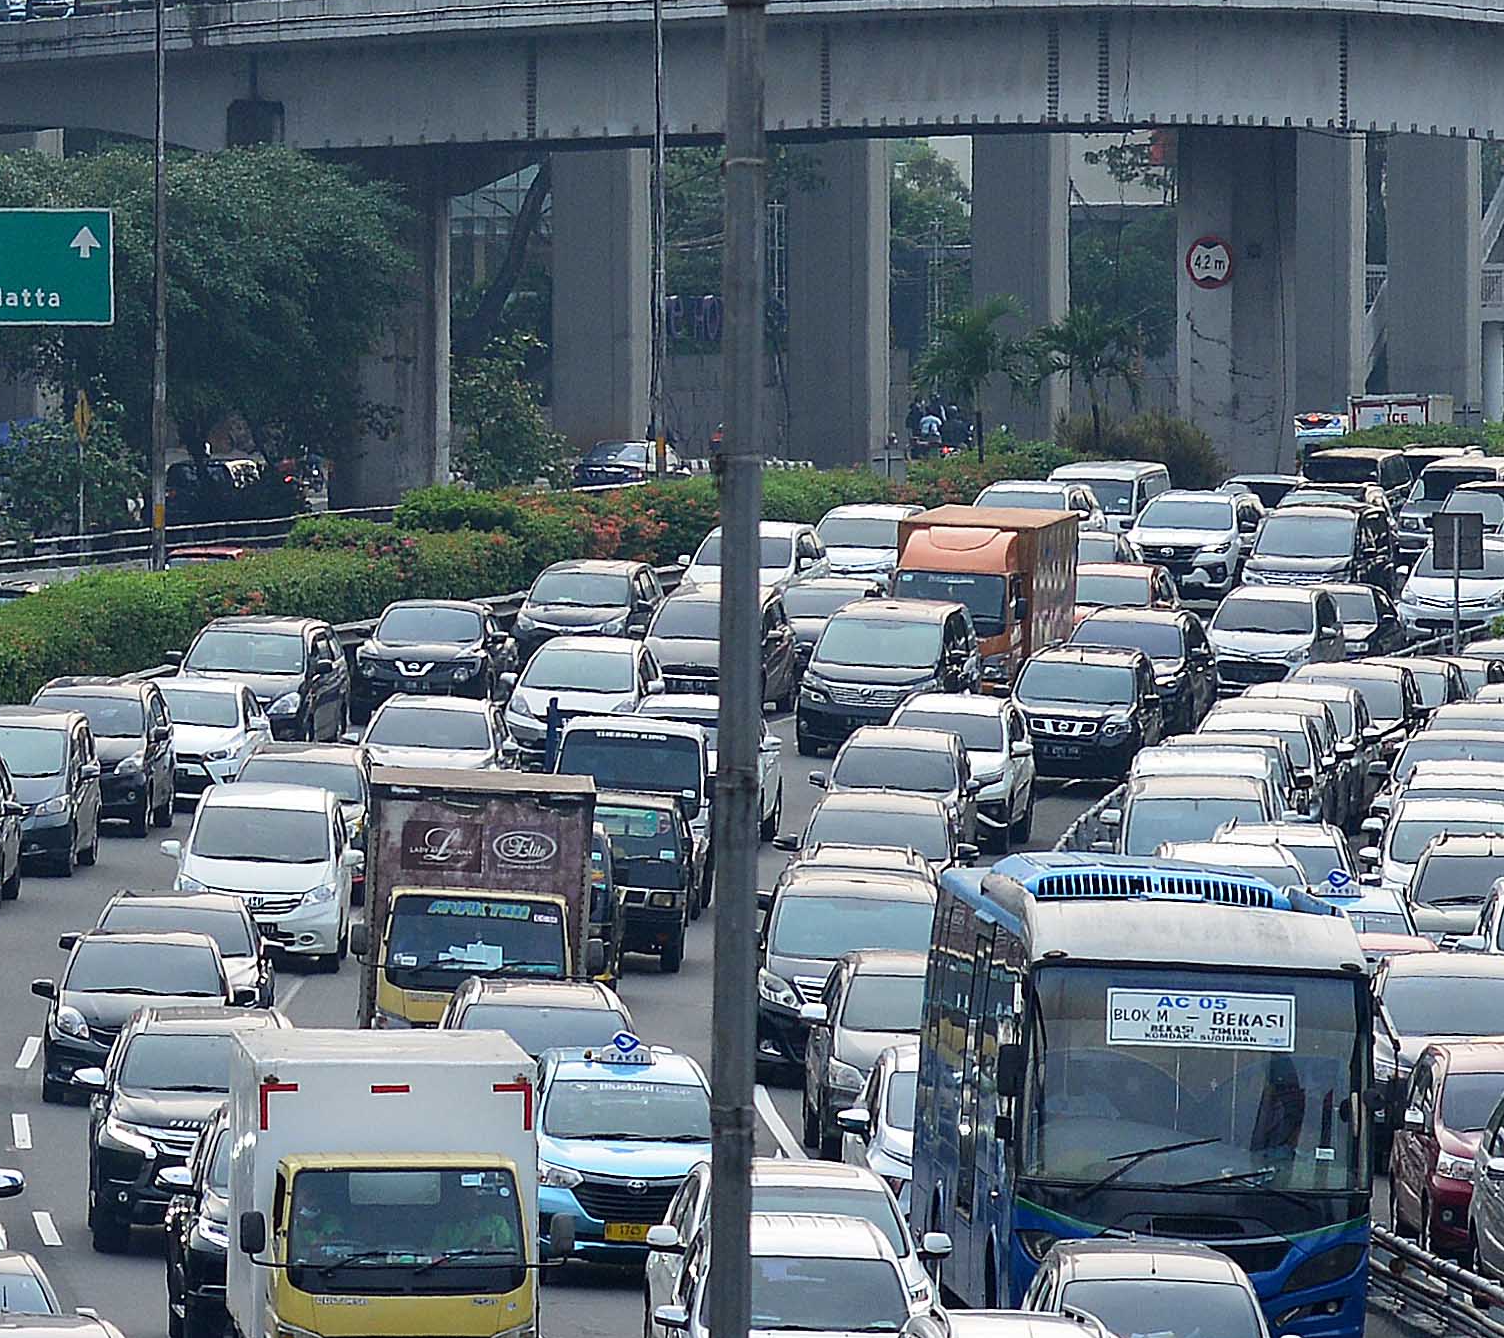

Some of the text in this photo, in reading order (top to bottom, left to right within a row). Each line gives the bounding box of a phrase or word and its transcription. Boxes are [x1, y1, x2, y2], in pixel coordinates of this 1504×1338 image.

[1214, 259, 1225, 269] m
[640, 733, 667, 741] KING
[1157, 996, 1228, 1010] AC 05
[1113, 1008, 1151, 1022] BLOK
[1157, 1009, 1169, 1022] M
[1211, 1011, 1285, 1028] BEKASI
[1150, 1024, 1251, 1037] BEKASI TIMUR
[1144, 1032, 1258, 1044] KOMDAK SUDIRMAN
[609, 1053, 644, 1062] TAKSI
[598, 1082, 653, 1093] Bluebird
